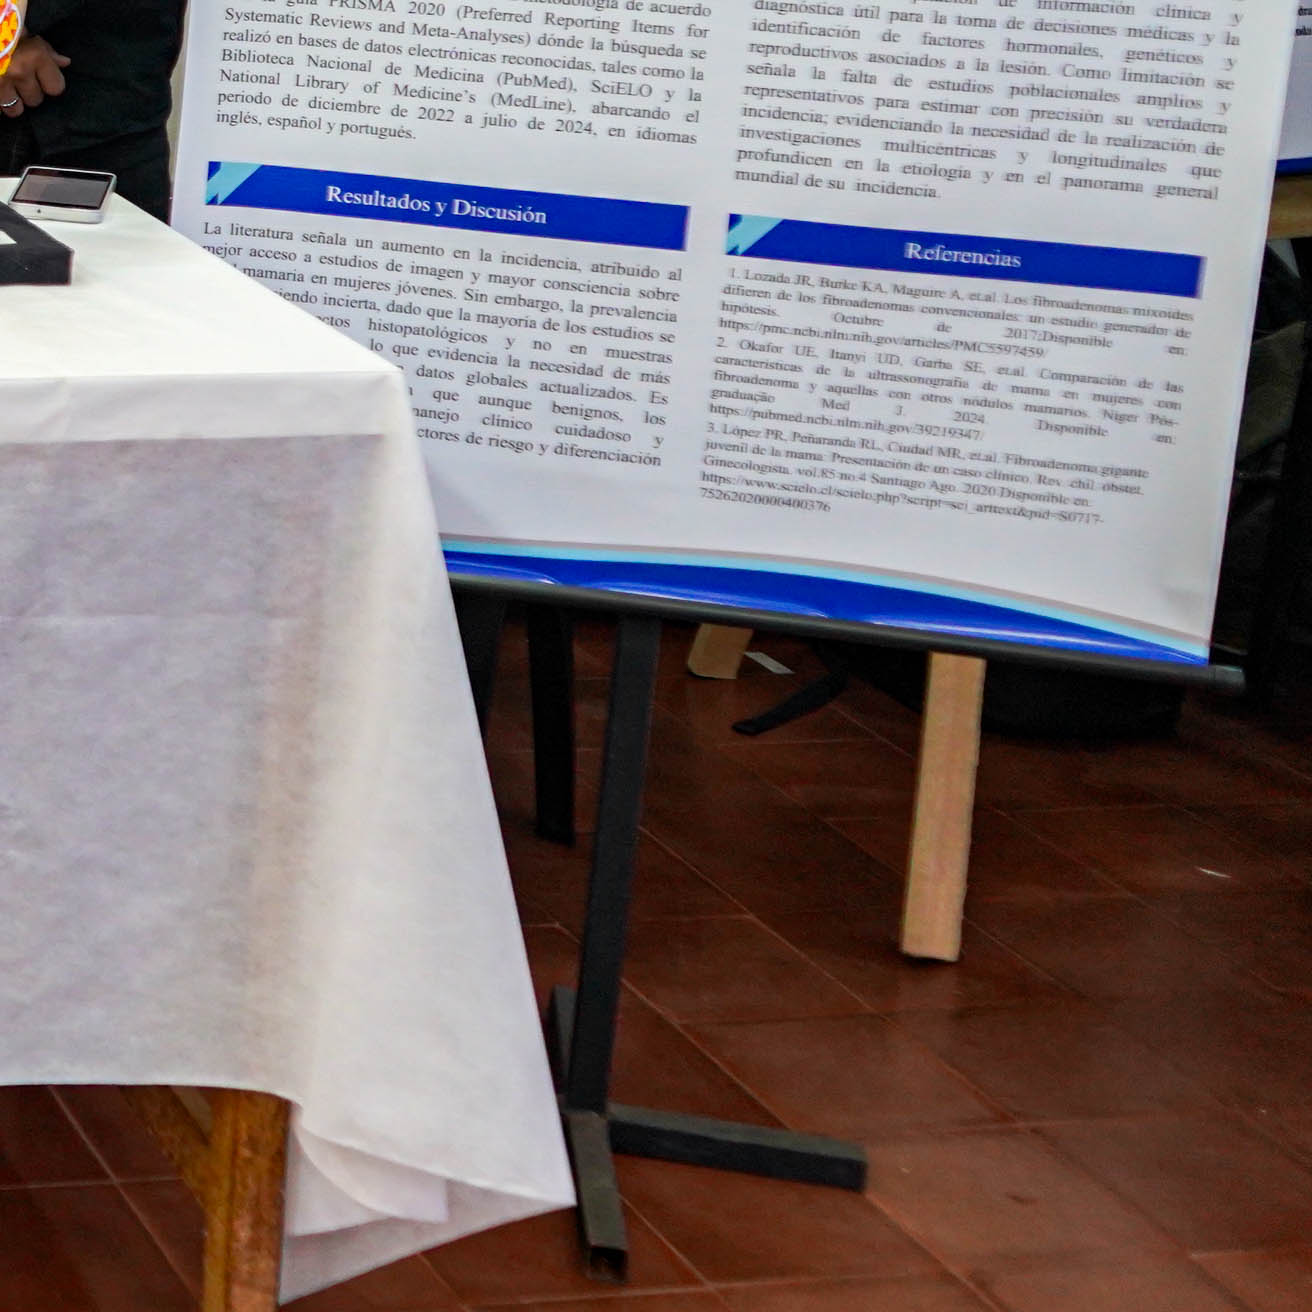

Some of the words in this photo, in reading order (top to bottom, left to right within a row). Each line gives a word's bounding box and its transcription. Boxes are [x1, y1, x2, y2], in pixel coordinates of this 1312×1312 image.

[327, 186, 430, 211] Resultados
[435, 201, 447, 217] y
[453, 198, 546, 224] Discusión
[204, 221, 221, 235] La
[230, 224, 293, 241] literatura
[302, 231, 346, 246] señala
[356, 238, 373, 249] un
[382, 241, 444, 257] aumento
[453, 249, 470, 260] en
[480, 248, 492, 263] la
[501, 254, 581, 272] incidencia,
[591, 262, 659, 279] atribuido
[668, 268, 681, 281] al
[905, 242, 1021, 267] Referencias
